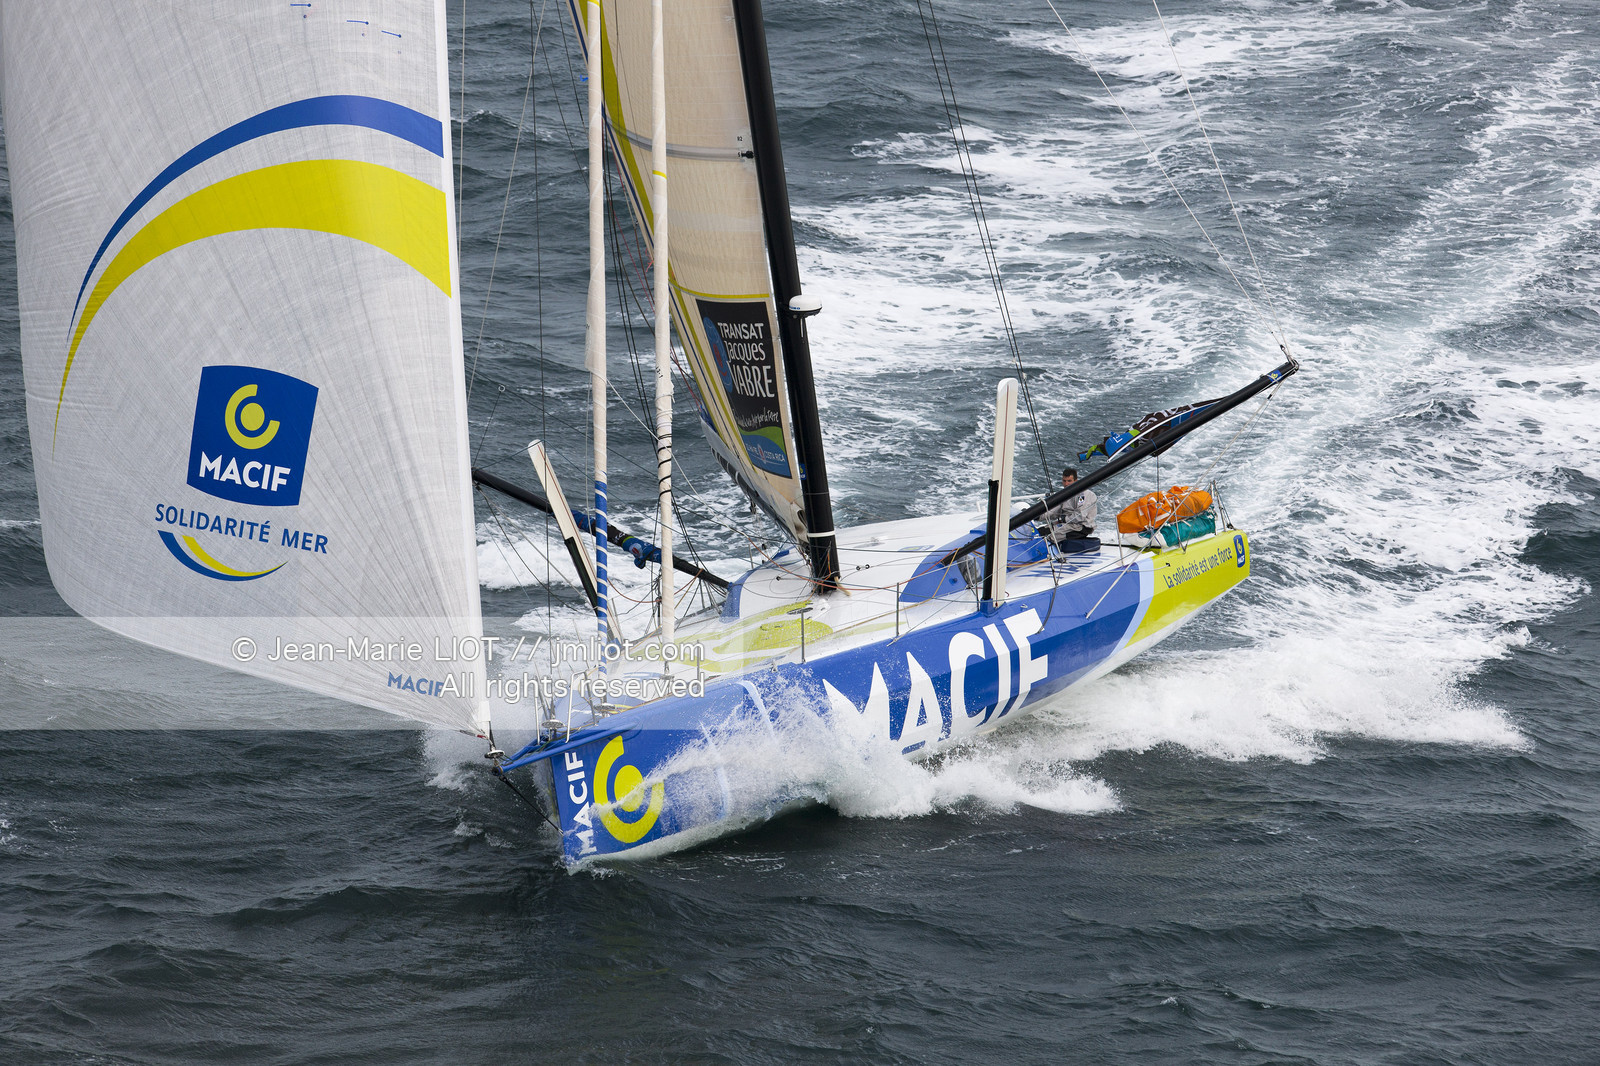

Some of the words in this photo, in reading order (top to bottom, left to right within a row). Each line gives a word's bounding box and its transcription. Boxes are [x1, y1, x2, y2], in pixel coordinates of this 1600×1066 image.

[717, 322, 764, 340] TRANSAT
[724, 340, 766, 365] Jacques
[726, 360, 775, 398] VABRE
[199, 450, 291, 492] MACIF
[155, 503, 271, 543] SOLIDARITÉ
[281, 528, 329, 554] MER
[1163, 574, 1175, 589] La
[1173, 559, 1201, 586] solidarité
[1199, 556, 1210, 574] est
[1217, 546, 1233, 564] force
[820, 608, 1049, 758] MACIF
[564, 751, 597, 856] MACIF
